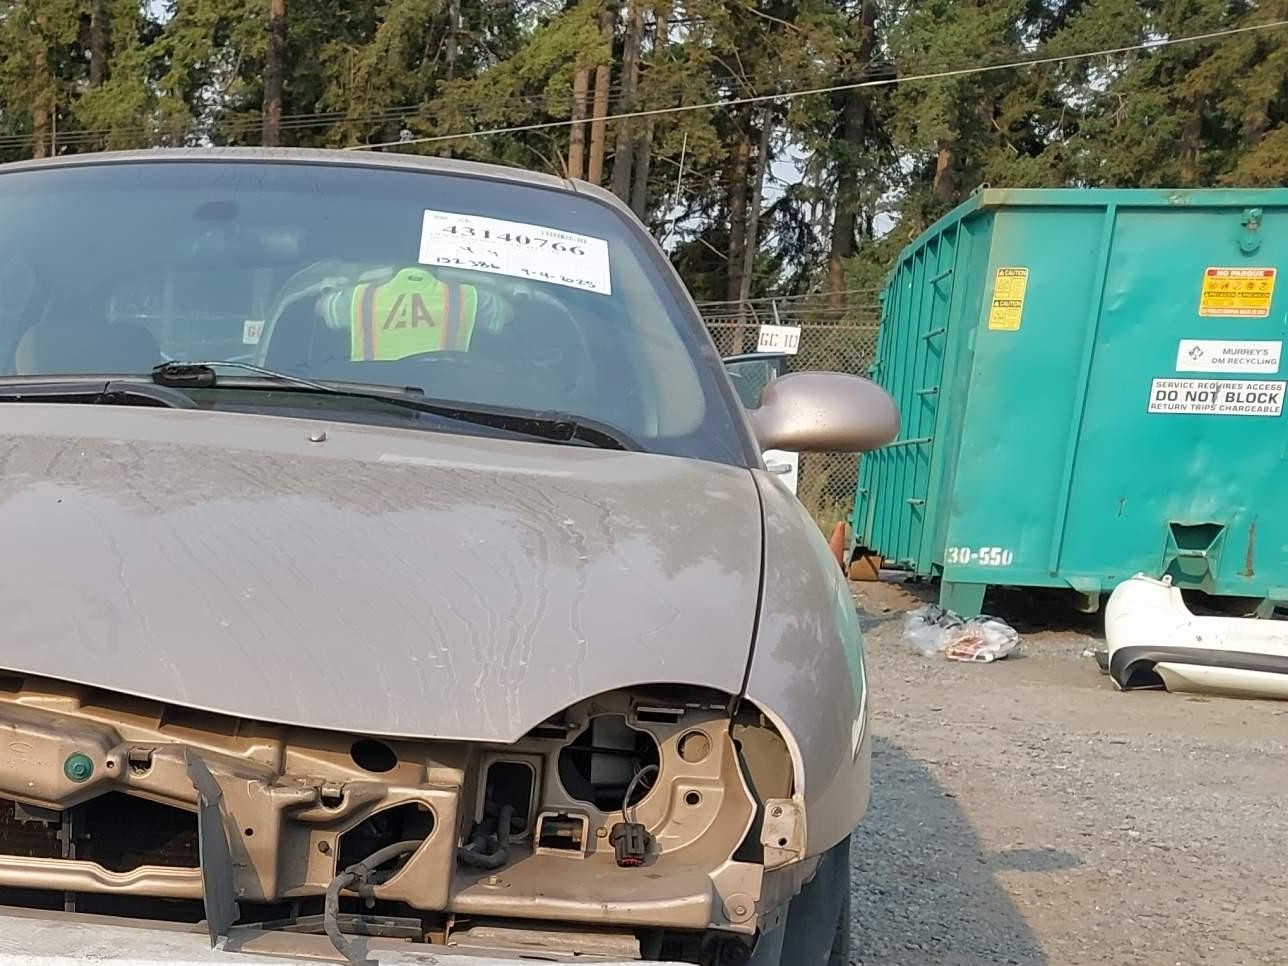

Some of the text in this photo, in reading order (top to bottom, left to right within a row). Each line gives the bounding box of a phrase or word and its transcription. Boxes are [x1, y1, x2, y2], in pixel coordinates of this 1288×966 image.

[442, 225, 585, 256] 43140766
[1227, 357, 1277, 365] RECYCLING
[1155, 381, 1193, 389] SERVICE
[1246, 383, 1283, 391] ACCESS
[1155, 390, 1279, 404] DO NOT BLOCK
[1150, 403, 1188, 411] RETURN
[1219, 404, 1281, 413] CHARGEABLE
[948, 547, 1013, 566] 30-550
